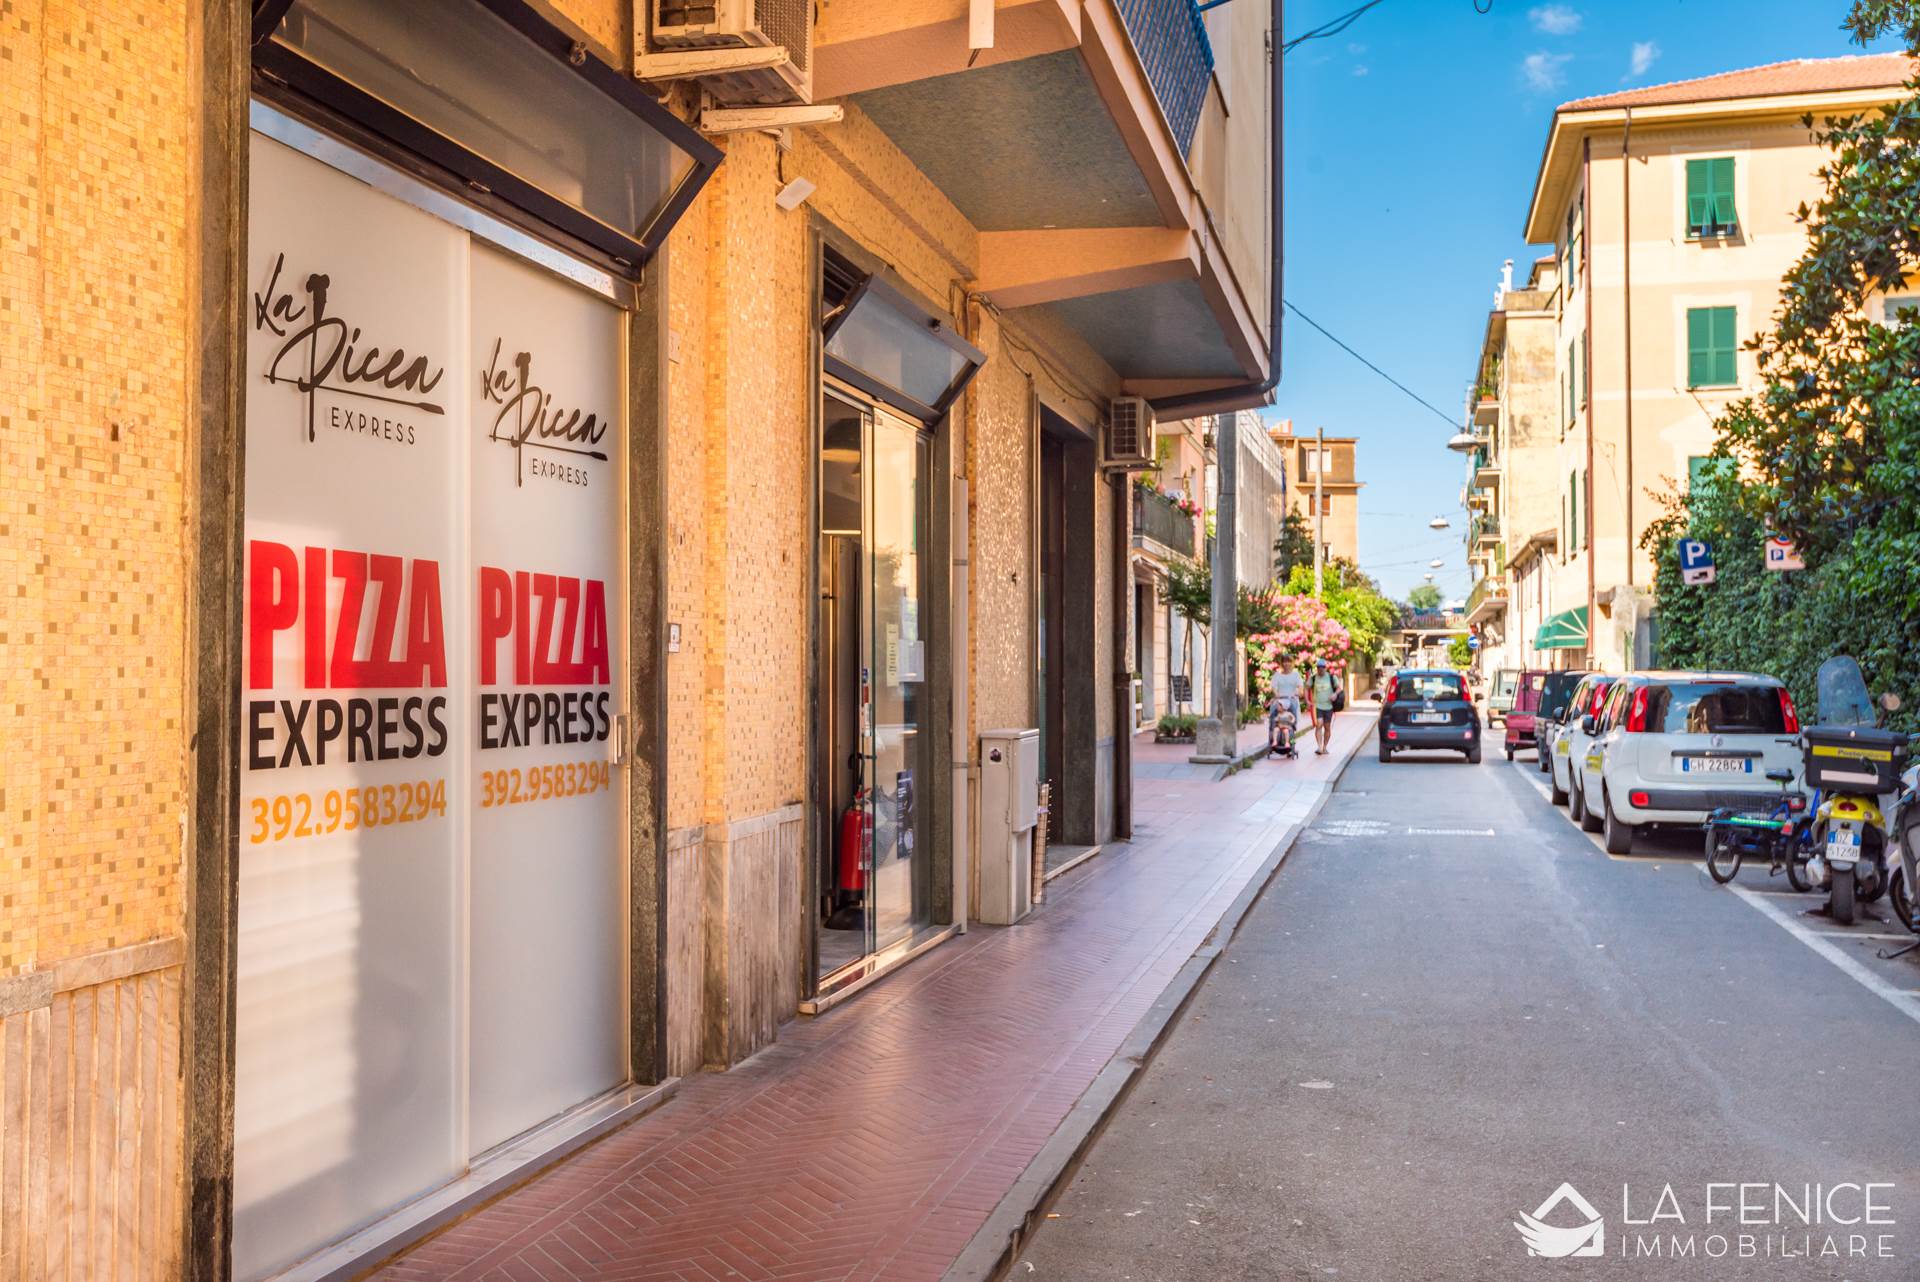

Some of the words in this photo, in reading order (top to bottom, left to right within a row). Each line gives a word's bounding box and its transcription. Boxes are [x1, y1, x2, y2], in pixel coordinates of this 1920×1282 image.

[255, 252, 306, 336] La
[482, 337, 516, 404] La
[331, 406, 416, 445] EXPRESS
[532, 458, 588, 487] EXPRESS
[1686, 541, 1706, 566] P
[250, 540, 447, 690] PIZZA
[481, 566, 610, 685] PIZZA
[249, 696, 448, 770] EXPRESS
[481, 691, 610, 749] EXPRESS
[250, 778, 447, 844] 392.9583294
[481, 760, 610, 809] 392.9583294
